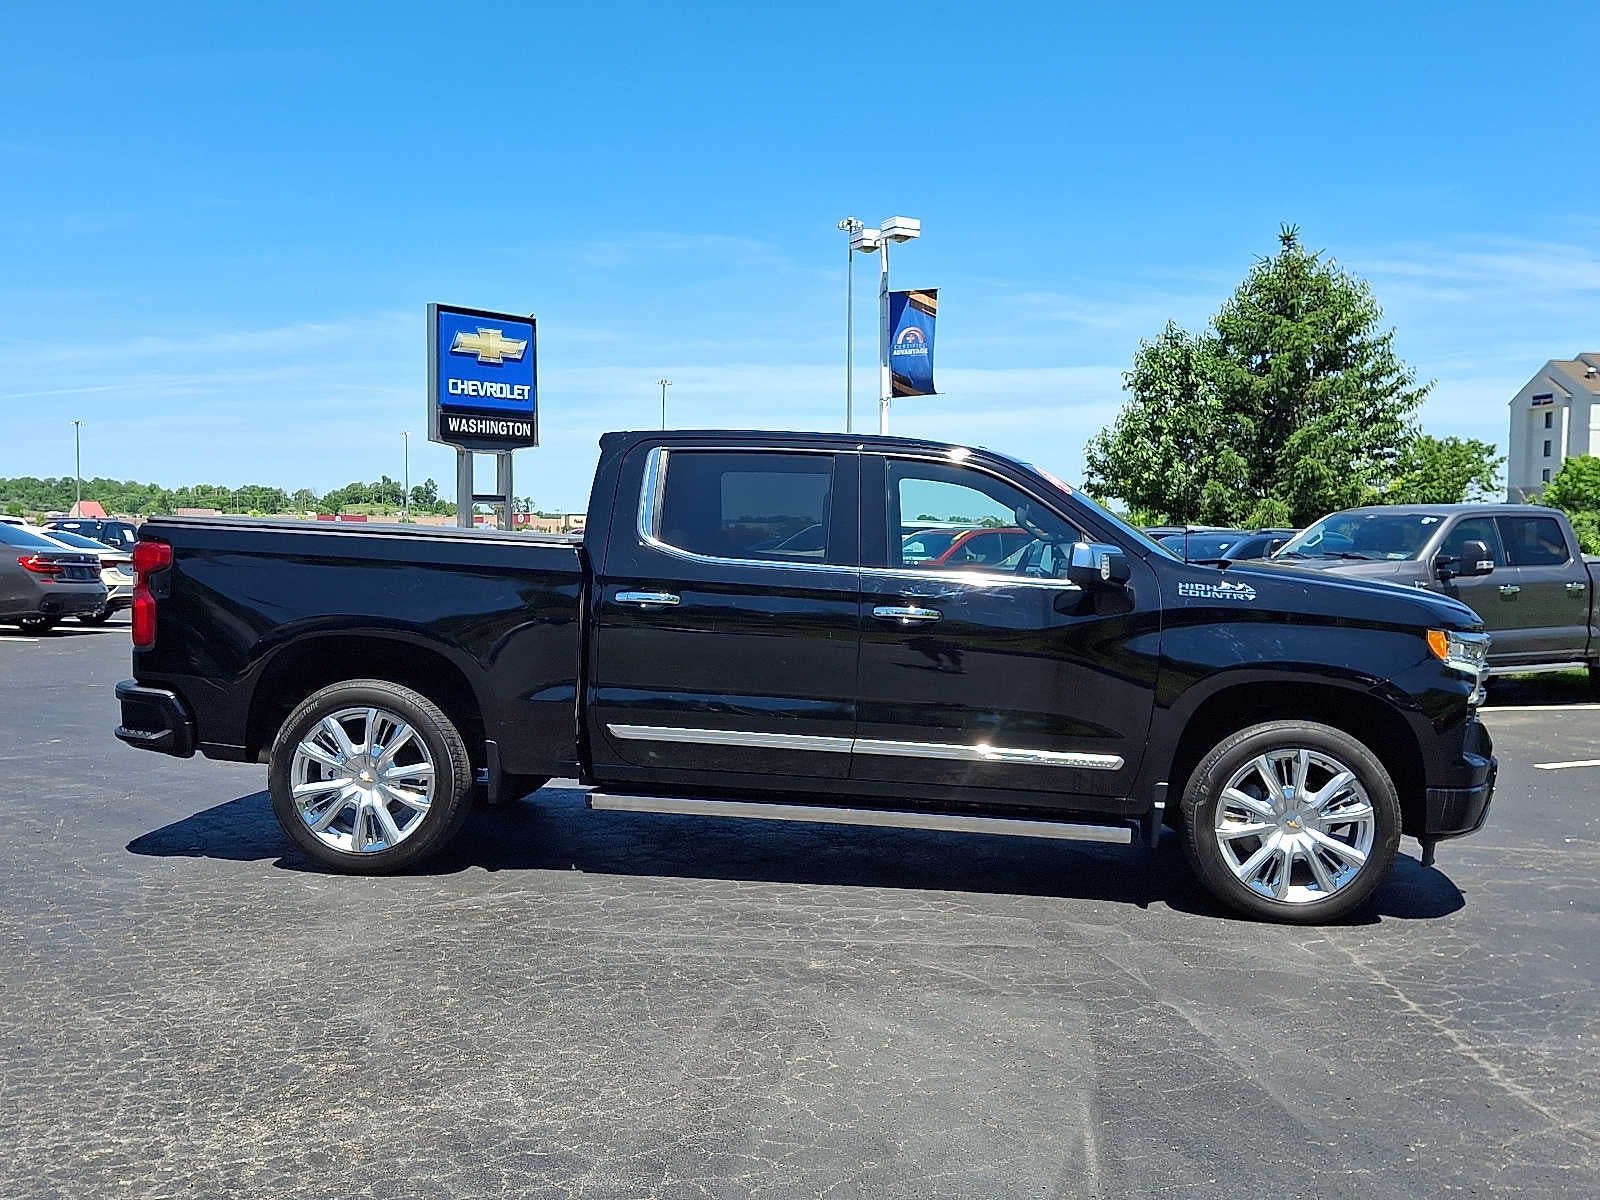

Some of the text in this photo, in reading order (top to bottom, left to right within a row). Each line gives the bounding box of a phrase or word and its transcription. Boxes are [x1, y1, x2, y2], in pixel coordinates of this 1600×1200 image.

[448, 378, 531, 400] CHEVROLET
[448, 417, 531, 437] WASHINGTON
[1178, 582, 1217, 592] HIGH
[1178, 588, 1256, 601] COUNTRY
